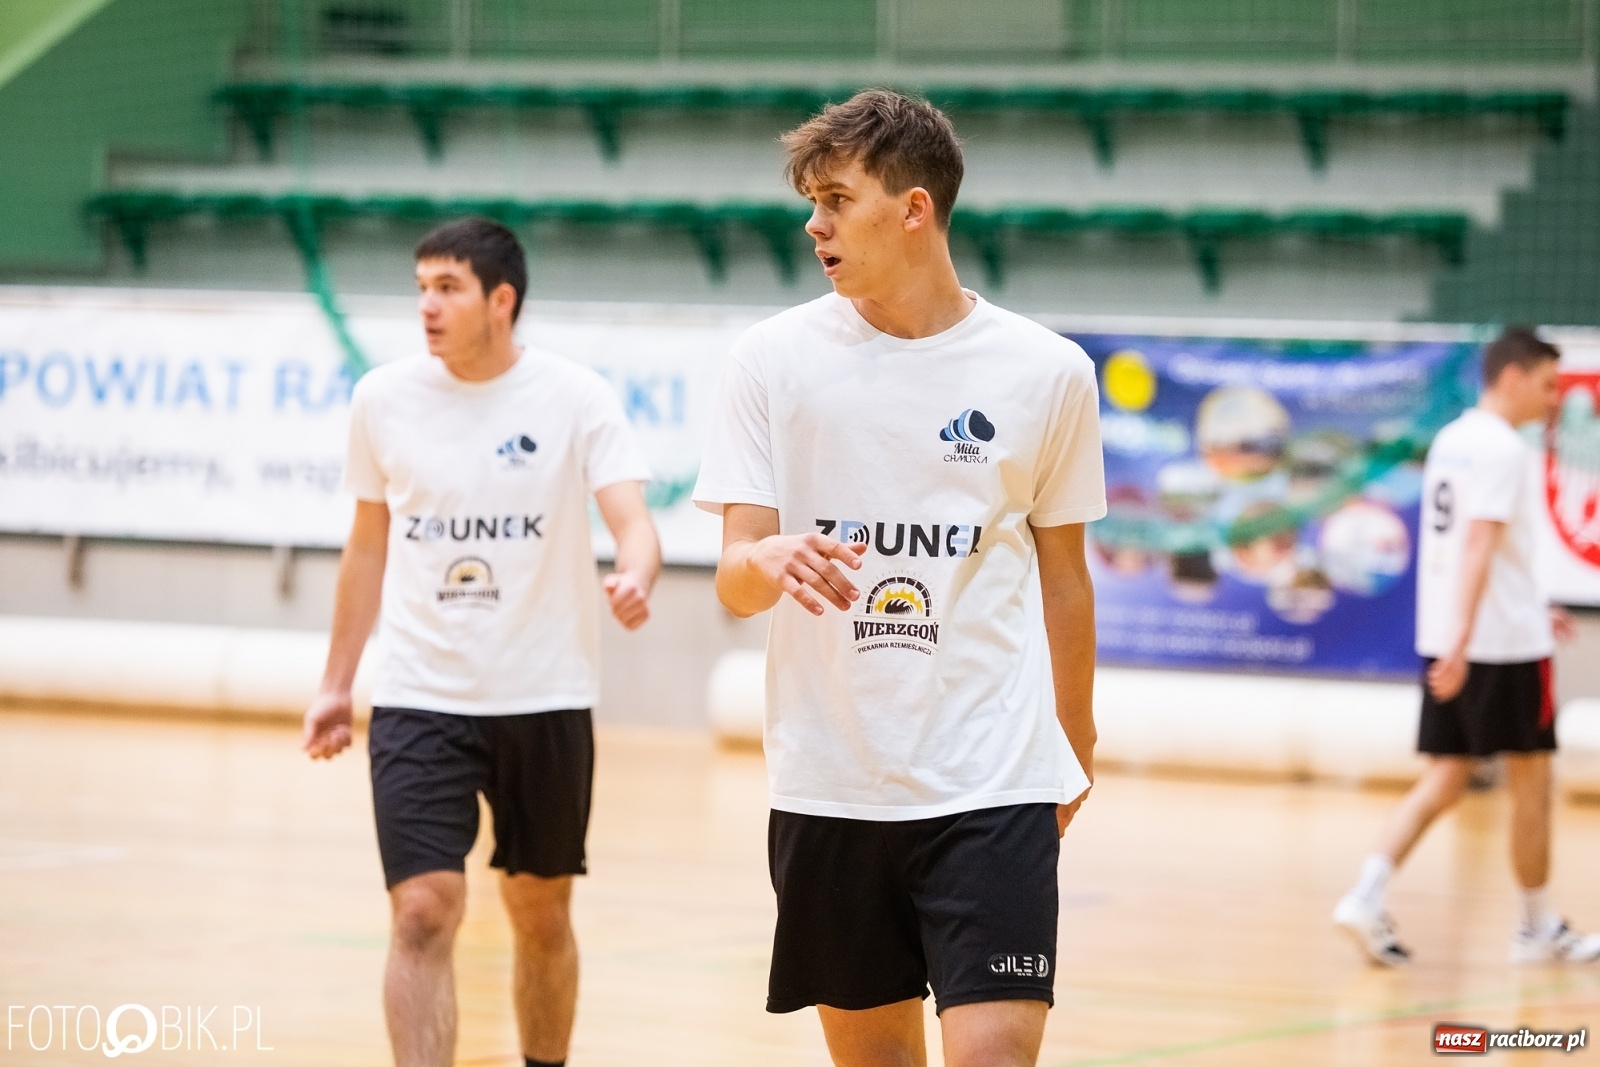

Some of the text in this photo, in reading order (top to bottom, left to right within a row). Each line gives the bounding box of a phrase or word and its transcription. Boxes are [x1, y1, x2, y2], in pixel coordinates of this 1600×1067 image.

[0, 350, 246, 411] POWIAT
[1432, 480, 1455, 534] 9
[405, 515, 543, 541] ZDUNEK
[853, 621, 939, 645] WIERZGOŃ
[857, 642, 889, 654] PIEKARNIA
